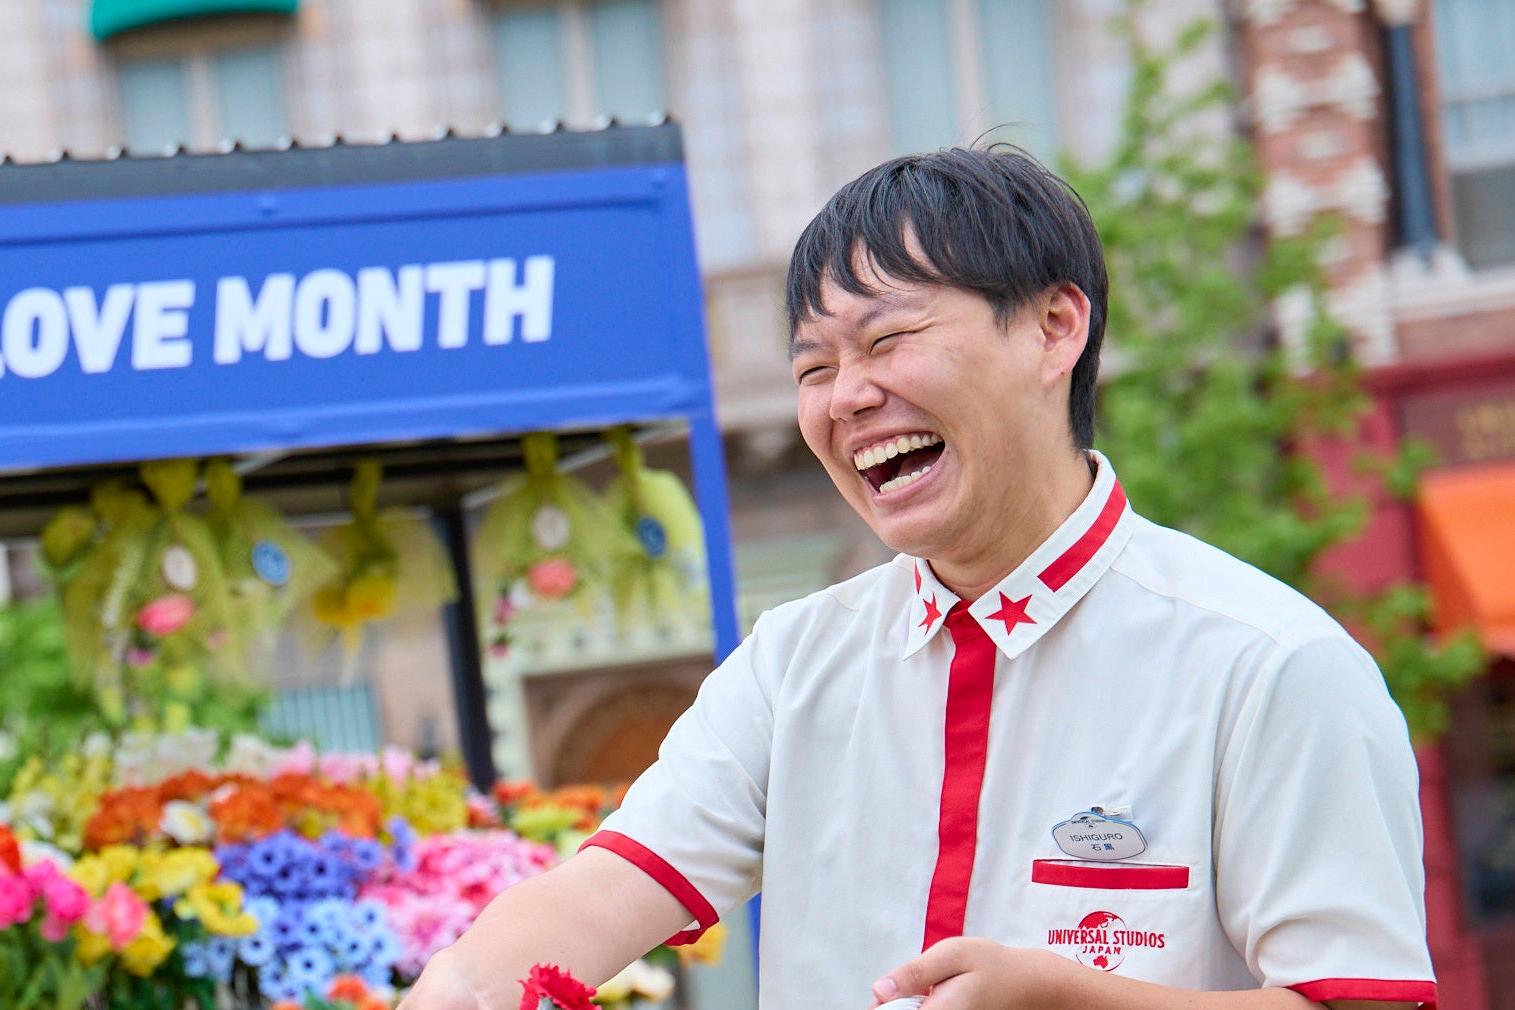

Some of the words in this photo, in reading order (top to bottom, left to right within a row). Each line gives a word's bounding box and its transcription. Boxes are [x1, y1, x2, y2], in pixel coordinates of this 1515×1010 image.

[213, 257, 554, 365] MONTH
[1069, 832, 1124, 842] ISHIGURO
[1047, 929, 1109, 945] UNIVERSAL
[1112, 930, 1165, 948] STUDIOS
[1082, 945, 1122, 955] JAPAN
